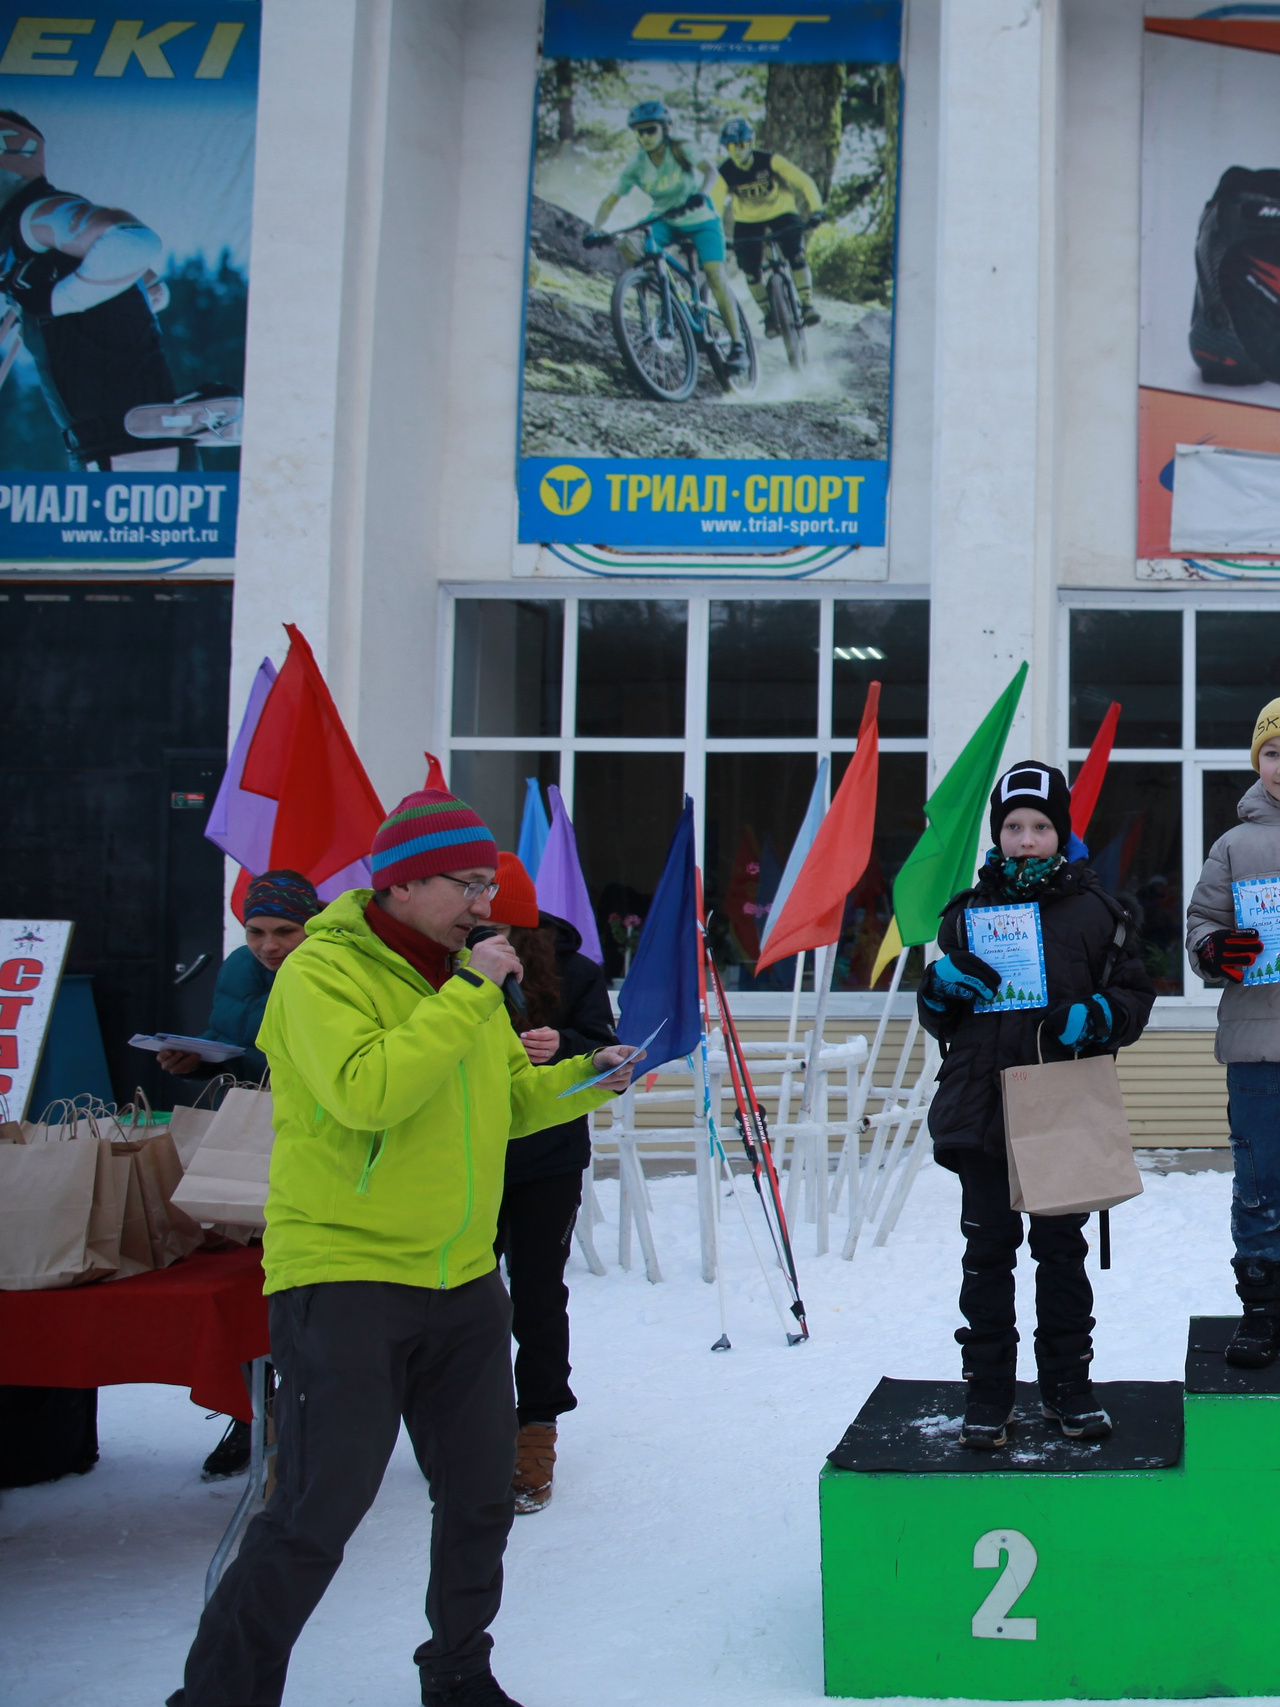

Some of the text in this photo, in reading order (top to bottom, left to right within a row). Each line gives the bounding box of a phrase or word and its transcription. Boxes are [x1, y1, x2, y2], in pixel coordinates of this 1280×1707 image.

[632, 13, 831, 41] GT
[61, 527, 219, 546] www.trial-sport.ru
[701, 517, 858, 536] www.trial-sport.ru
[981, 931, 1028, 943] ГРАМОТА
[742, 1113, 755, 1146] NORDWAY
[972, 1529, 1038, 1640] 2
